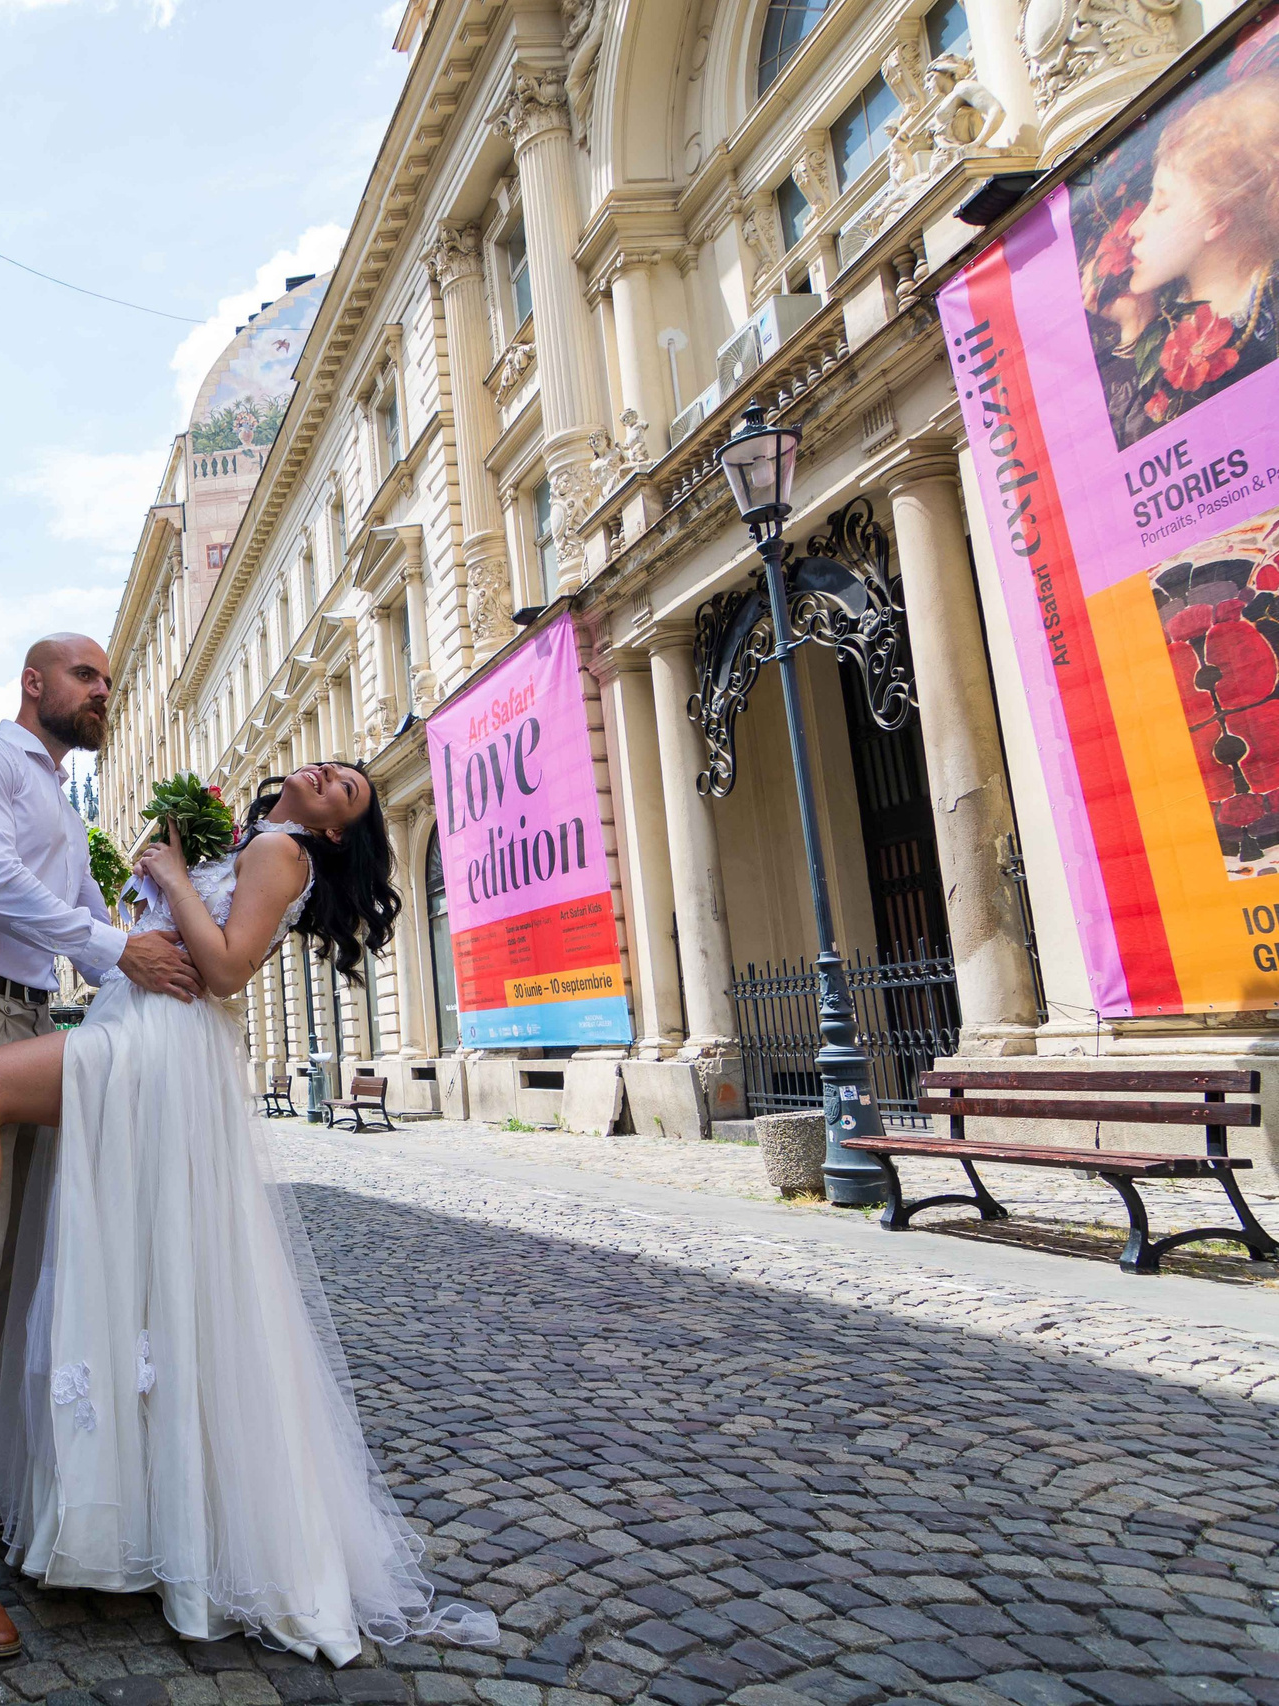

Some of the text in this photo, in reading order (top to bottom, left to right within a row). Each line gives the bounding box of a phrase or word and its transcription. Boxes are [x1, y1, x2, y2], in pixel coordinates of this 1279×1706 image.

[1125, 439, 1193, 497] LOVE
[1133, 449, 1248, 528] STORIES
[1141, 467, 1279, 547] Portraits, Passion & P
[1032, 564, 1070, 666] Art Safari
[469, 674, 535, 748] Art Safari
[442, 717, 542, 837] Love
[468, 815, 588, 904] edition
[560, 902, 602, 920] Art Safari Kids
[513, 983, 524, 999] 30
[524, 981, 543, 997] iunie
[550, 978, 560, 994] 10
[561, 972, 613, 995] septembrie
[1253, 943, 1279, 972] G
